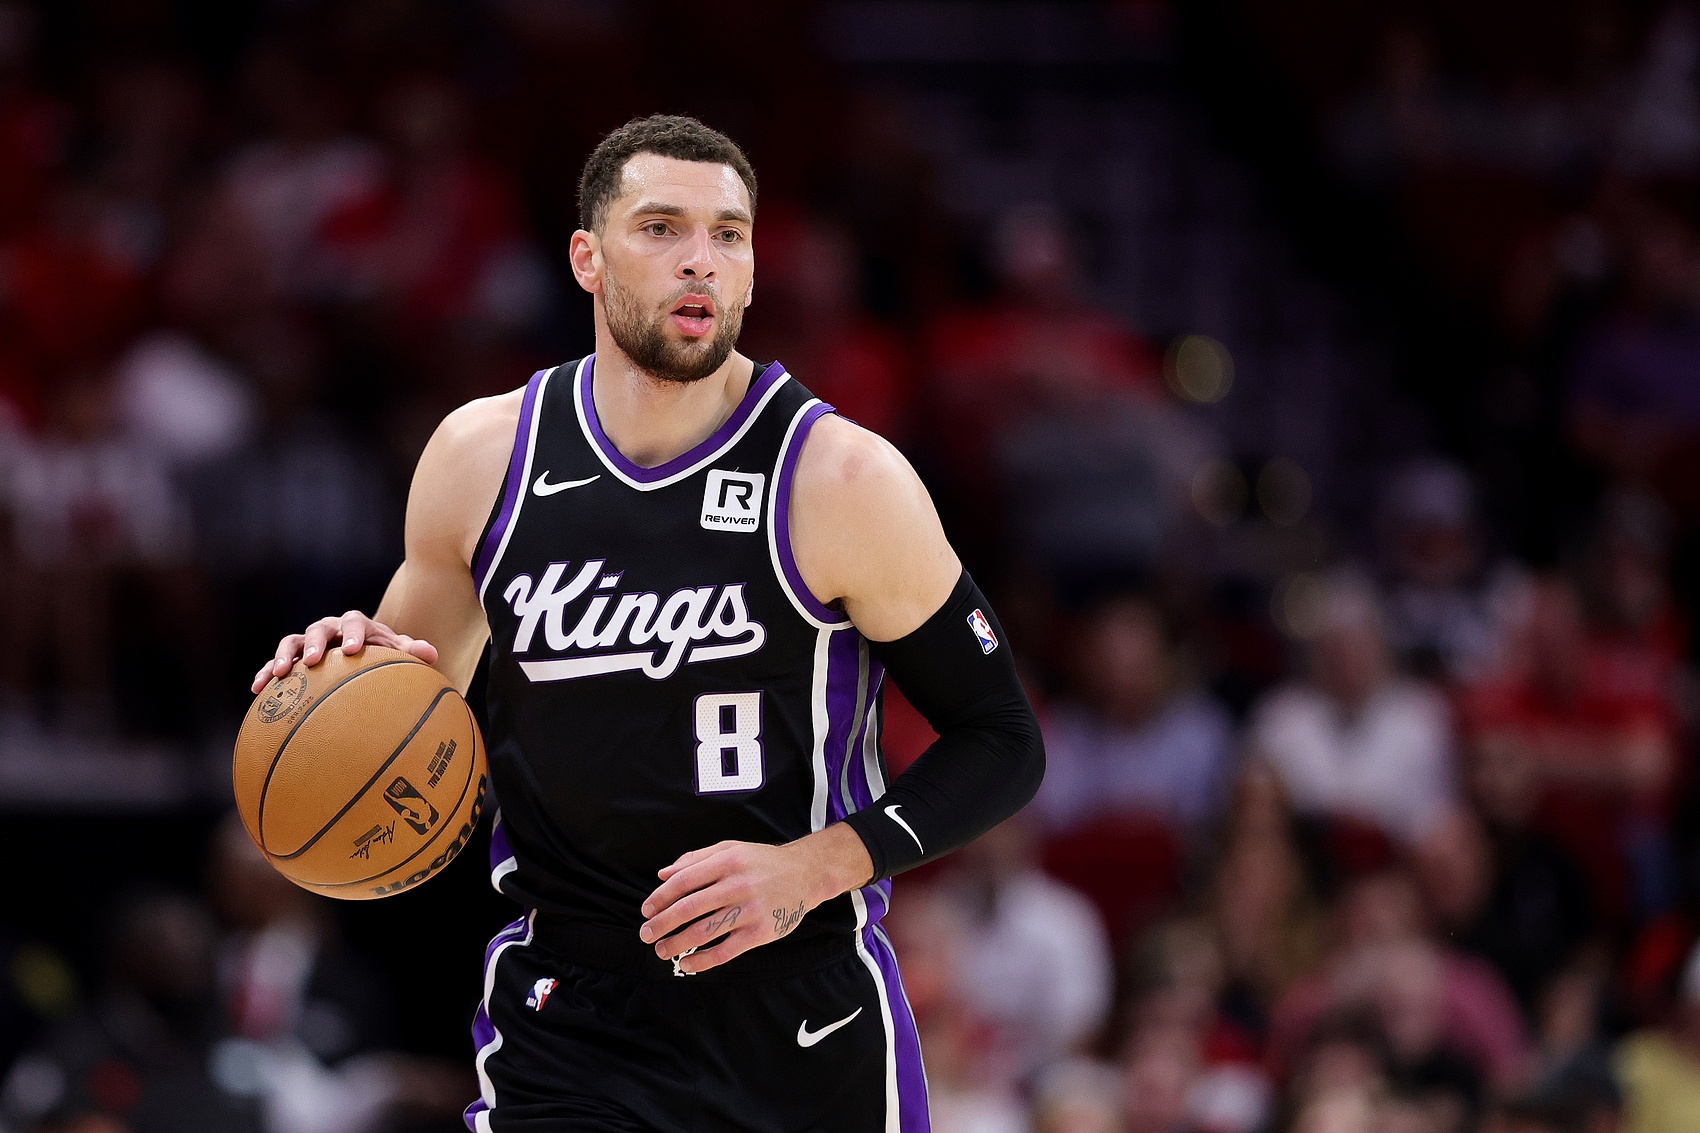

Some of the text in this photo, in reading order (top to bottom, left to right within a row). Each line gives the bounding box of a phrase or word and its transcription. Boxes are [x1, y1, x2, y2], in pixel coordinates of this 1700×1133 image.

[718, 478, 754, 510] R
[705, 514, 756, 526] REVIVER
[503, 558, 767, 683] Kings
[693, 690, 766, 796] 8
[391, 779, 408, 796] NBA
[772, 899, 806, 936] Elijah
